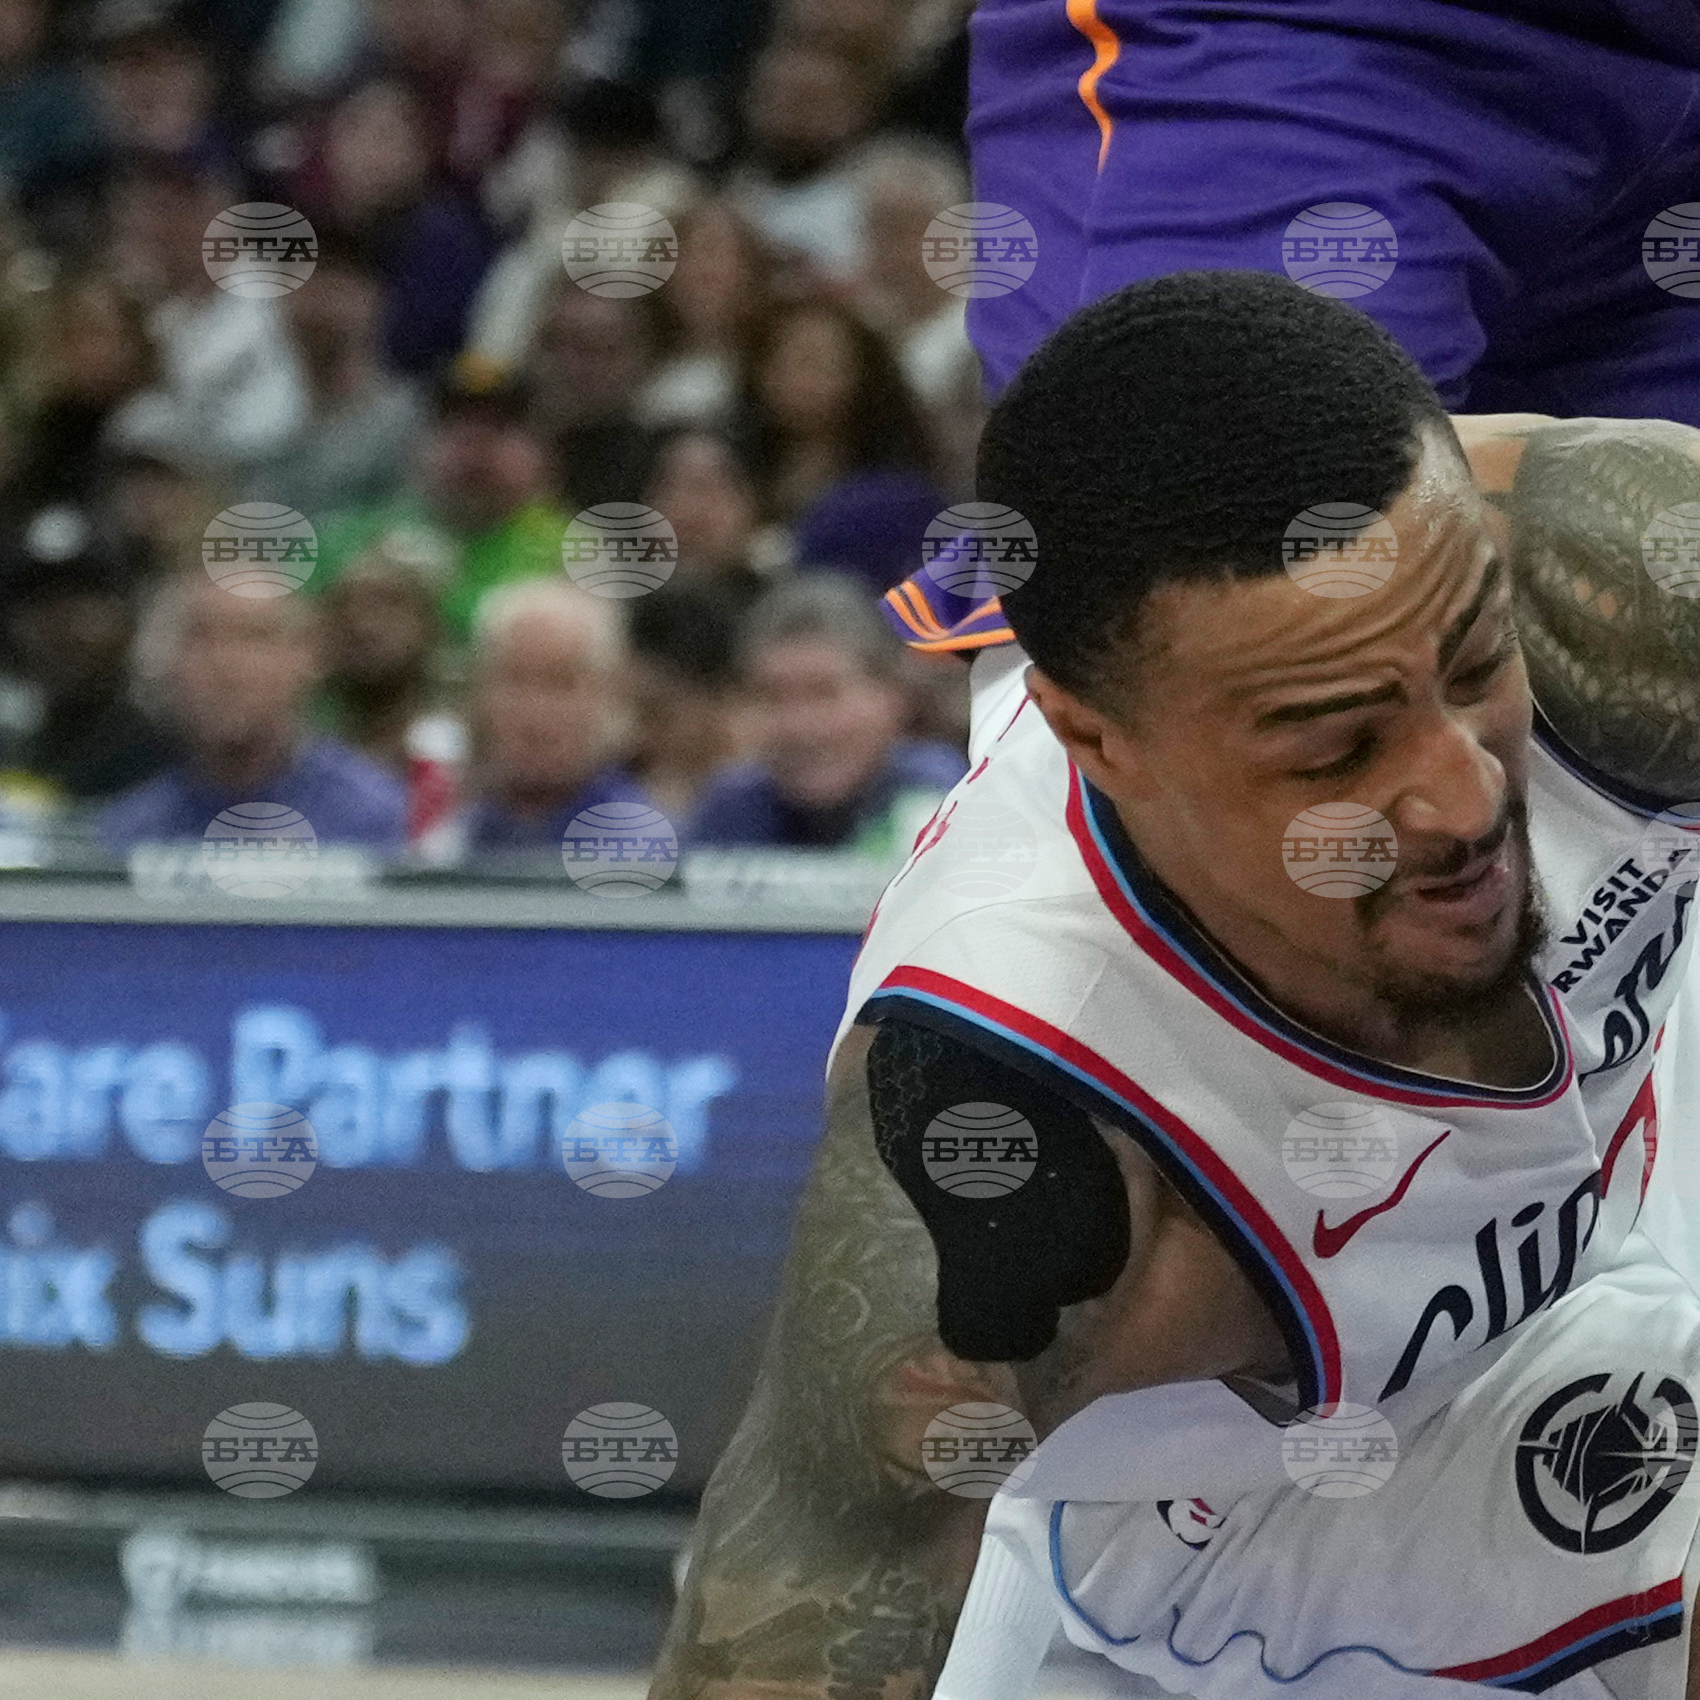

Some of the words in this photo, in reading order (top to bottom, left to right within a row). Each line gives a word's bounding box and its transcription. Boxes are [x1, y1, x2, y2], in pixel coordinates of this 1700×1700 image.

[1560, 858, 1645, 947] VISIT
[0, 1036, 210, 1165] are
[233, 1004, 736, 1172] Partner
[0, 1199, 118, 1348] ix
[137, 1198, 472, 1364] Suns
